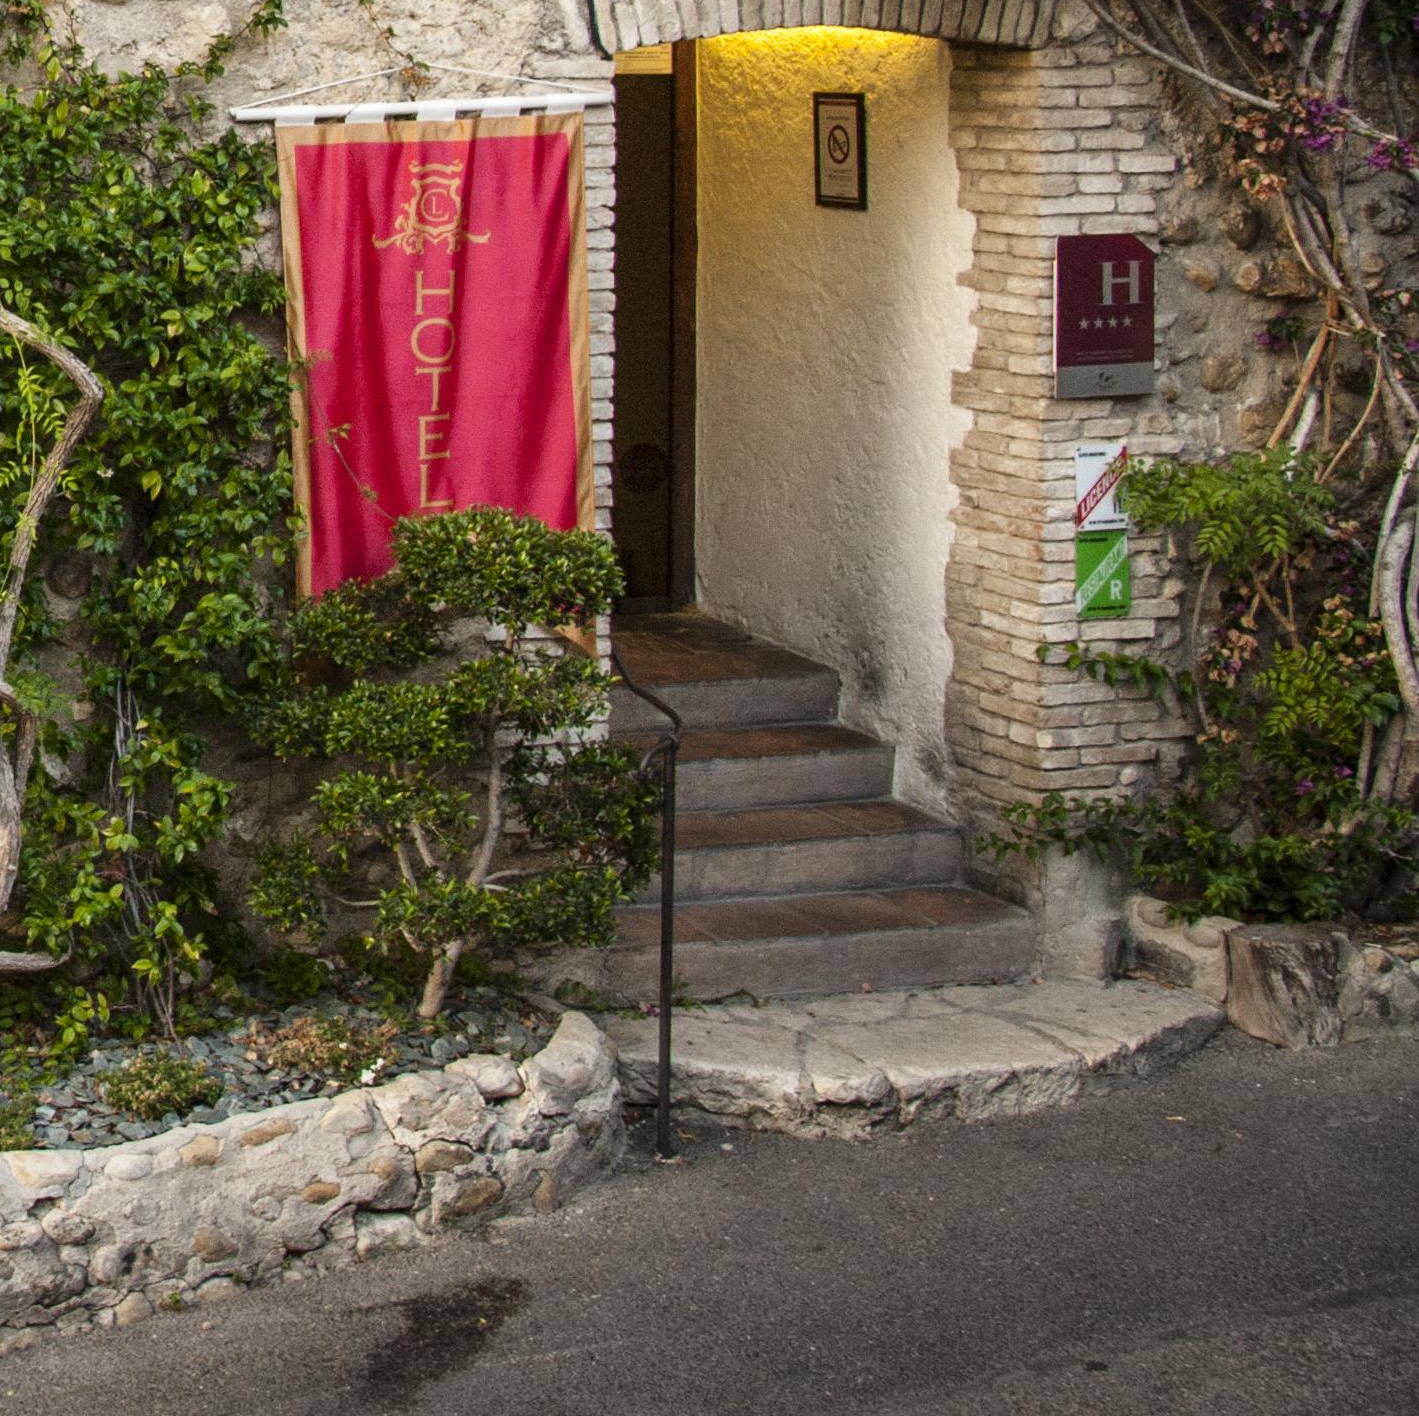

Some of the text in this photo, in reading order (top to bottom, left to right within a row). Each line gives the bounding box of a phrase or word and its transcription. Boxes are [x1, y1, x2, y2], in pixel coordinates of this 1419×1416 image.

[1099, 260, 1143, 305] H
[411, 270, 455, 508] HOTEL
[1110, 579, 1123, 600] R
